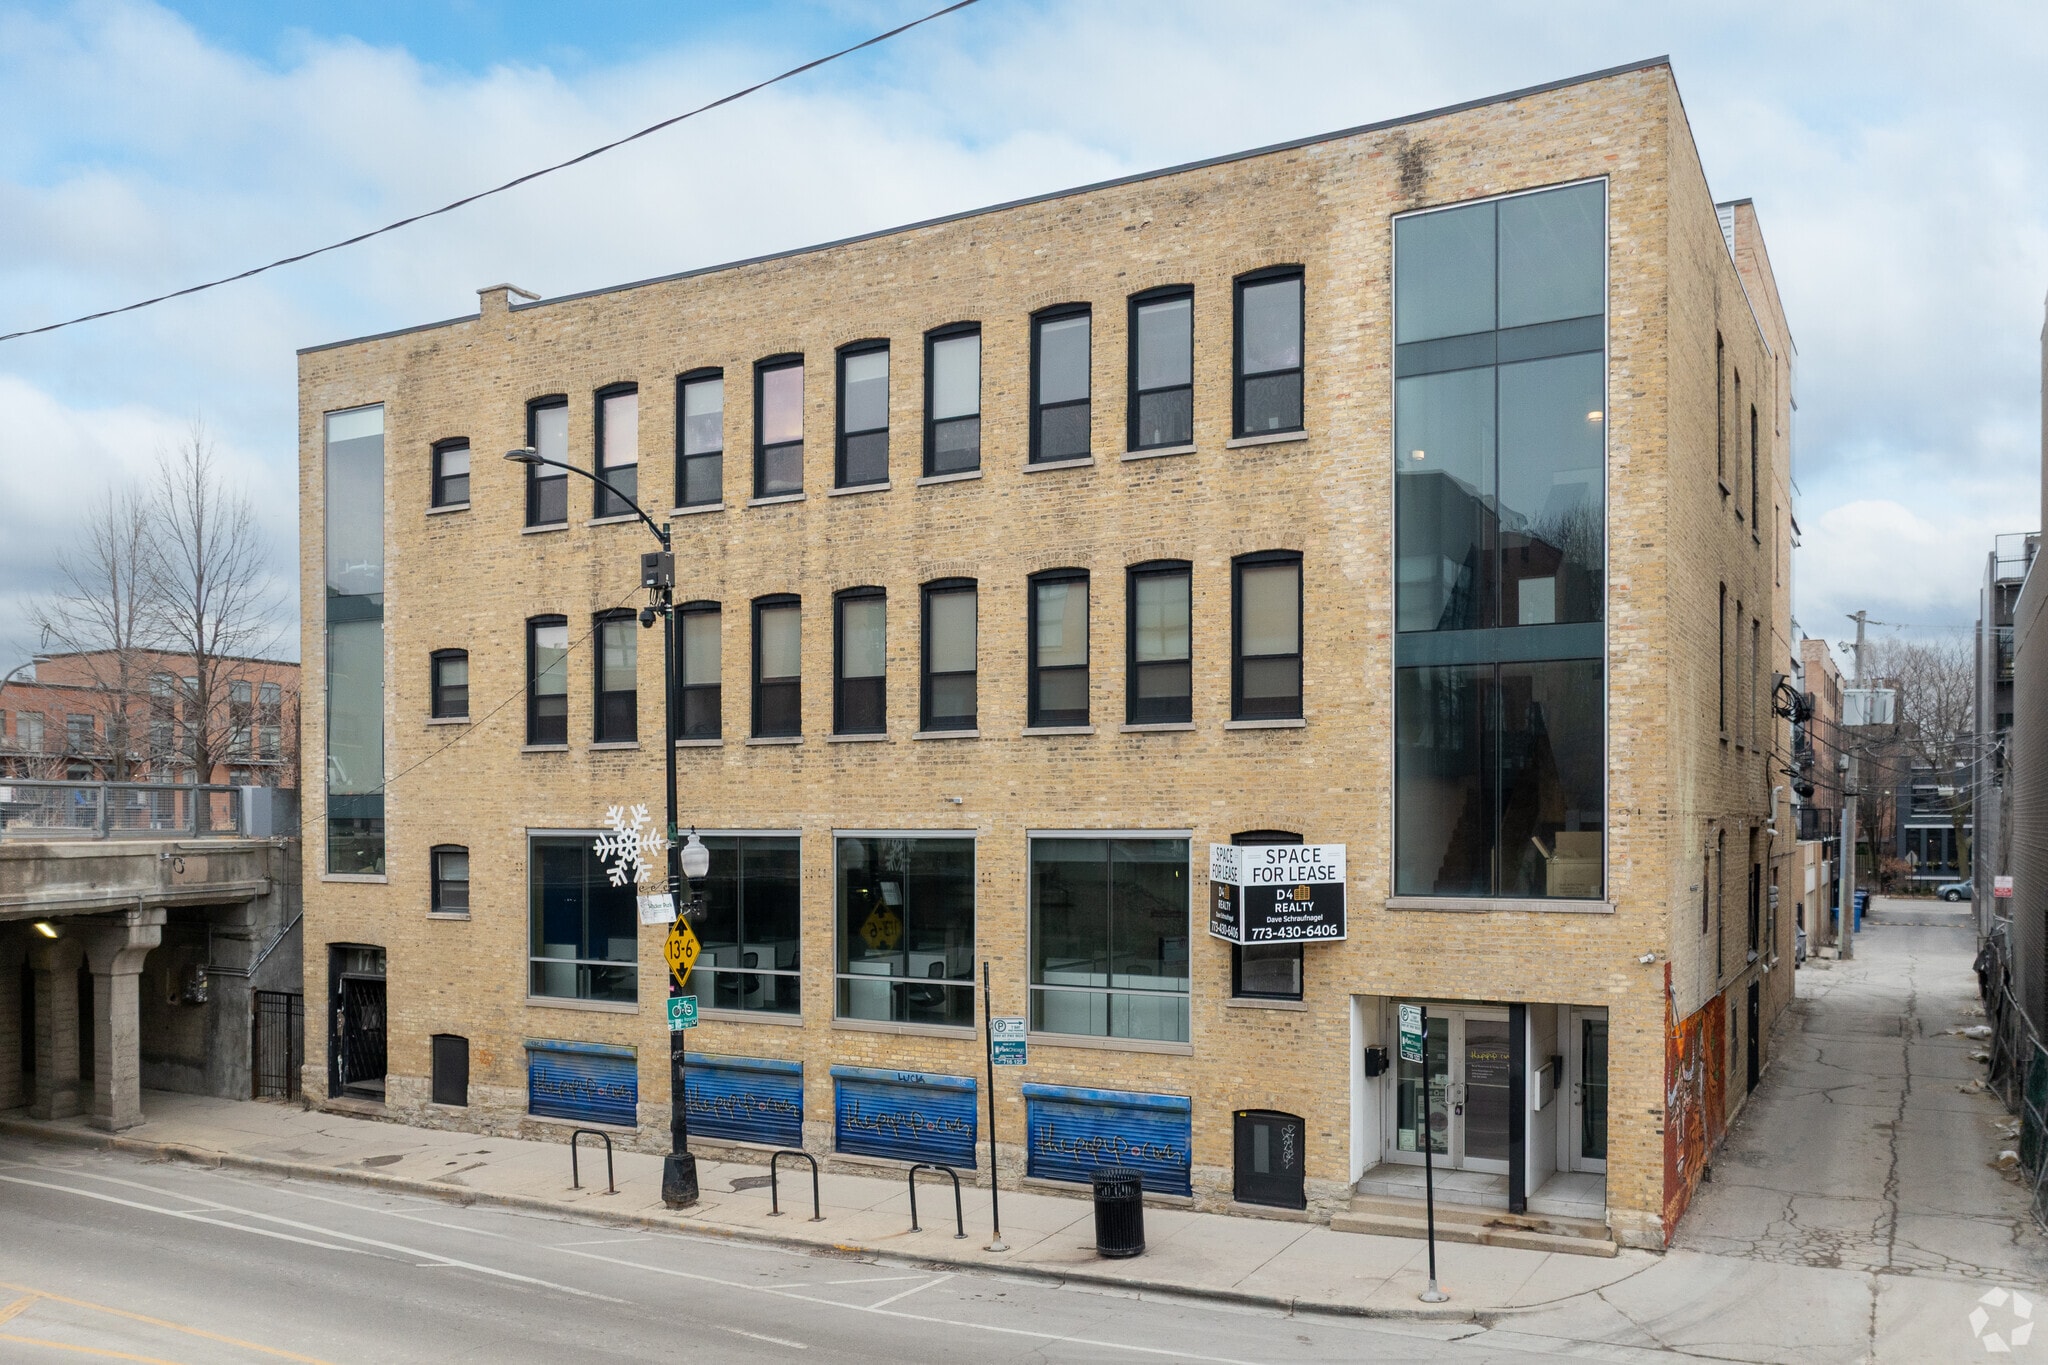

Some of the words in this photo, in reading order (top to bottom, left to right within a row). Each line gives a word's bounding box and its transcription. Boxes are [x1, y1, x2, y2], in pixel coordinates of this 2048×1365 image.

[1216, 847, 1233, 863] SPACE
[1266, 848, 1321, 864] SPACE
[1212, 864, 1222, 878] FOR
[1223, 865, 1238, 882] LEASE
[1253, 867, 1284, 882] FOR
[1289, 865, 1336, 881] LEASE
[1277, 889, 1293, 900] D4
[1218, 899, 1231, 911] REALTY
[1275, 902, 1314, 912] REALTY
[1252, 924, 1338, 939] 773-430-6406
